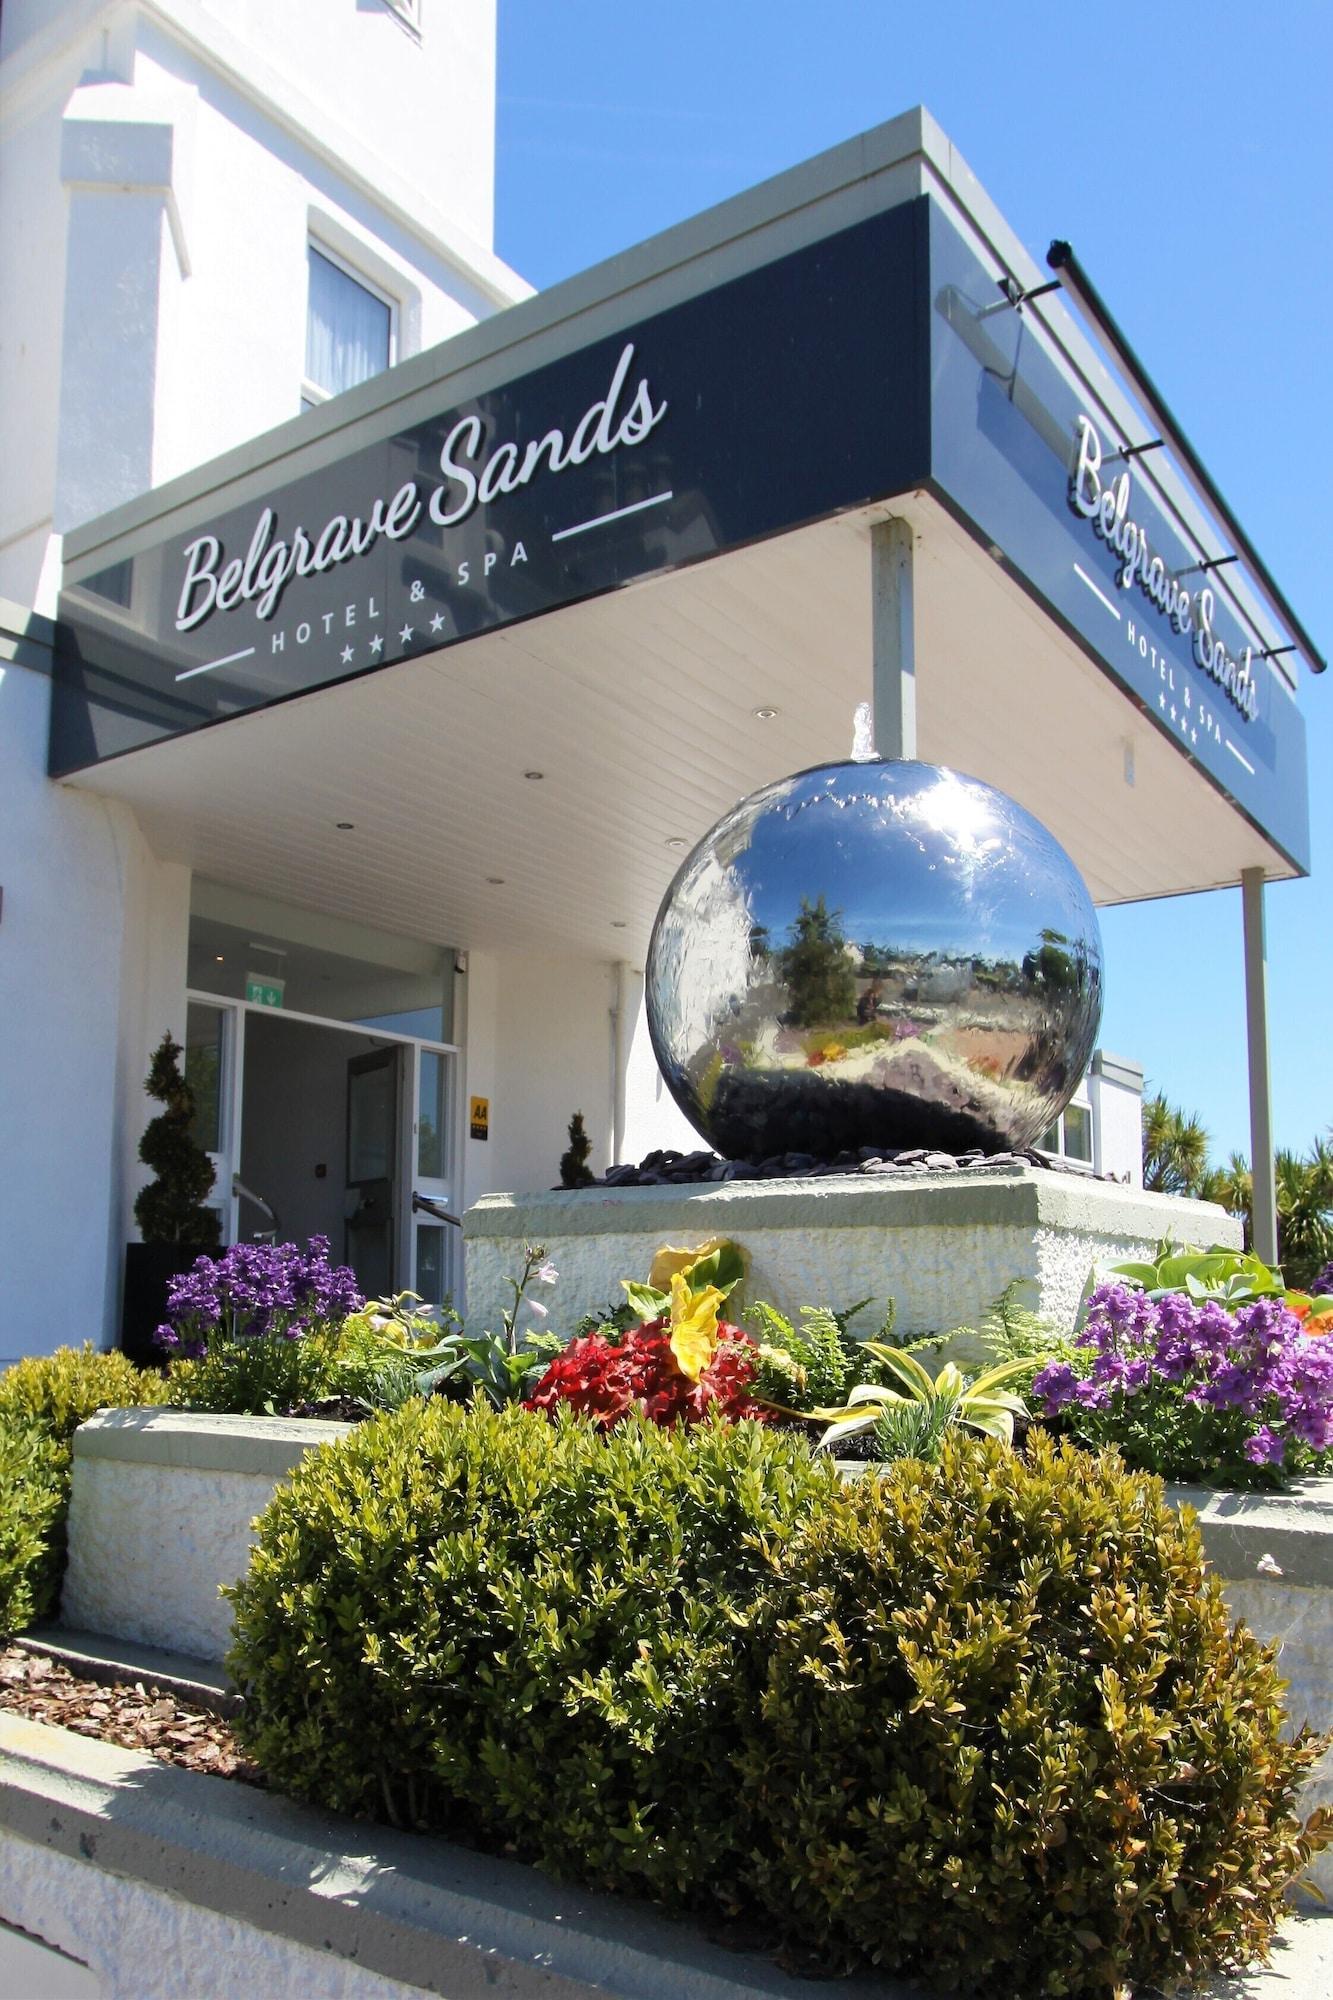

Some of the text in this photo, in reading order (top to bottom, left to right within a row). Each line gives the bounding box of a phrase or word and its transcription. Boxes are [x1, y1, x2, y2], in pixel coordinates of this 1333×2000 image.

[175, 342, 667, 632] Belgrave Sands
[271, 541, 529, 655] HOTEL & SPA
[1076, 414, 1260, 721] Belgrave Sands
[1127, 620, 1222, 743] HOTEL & SPA
[473, 1104, 487, 1121] AA
